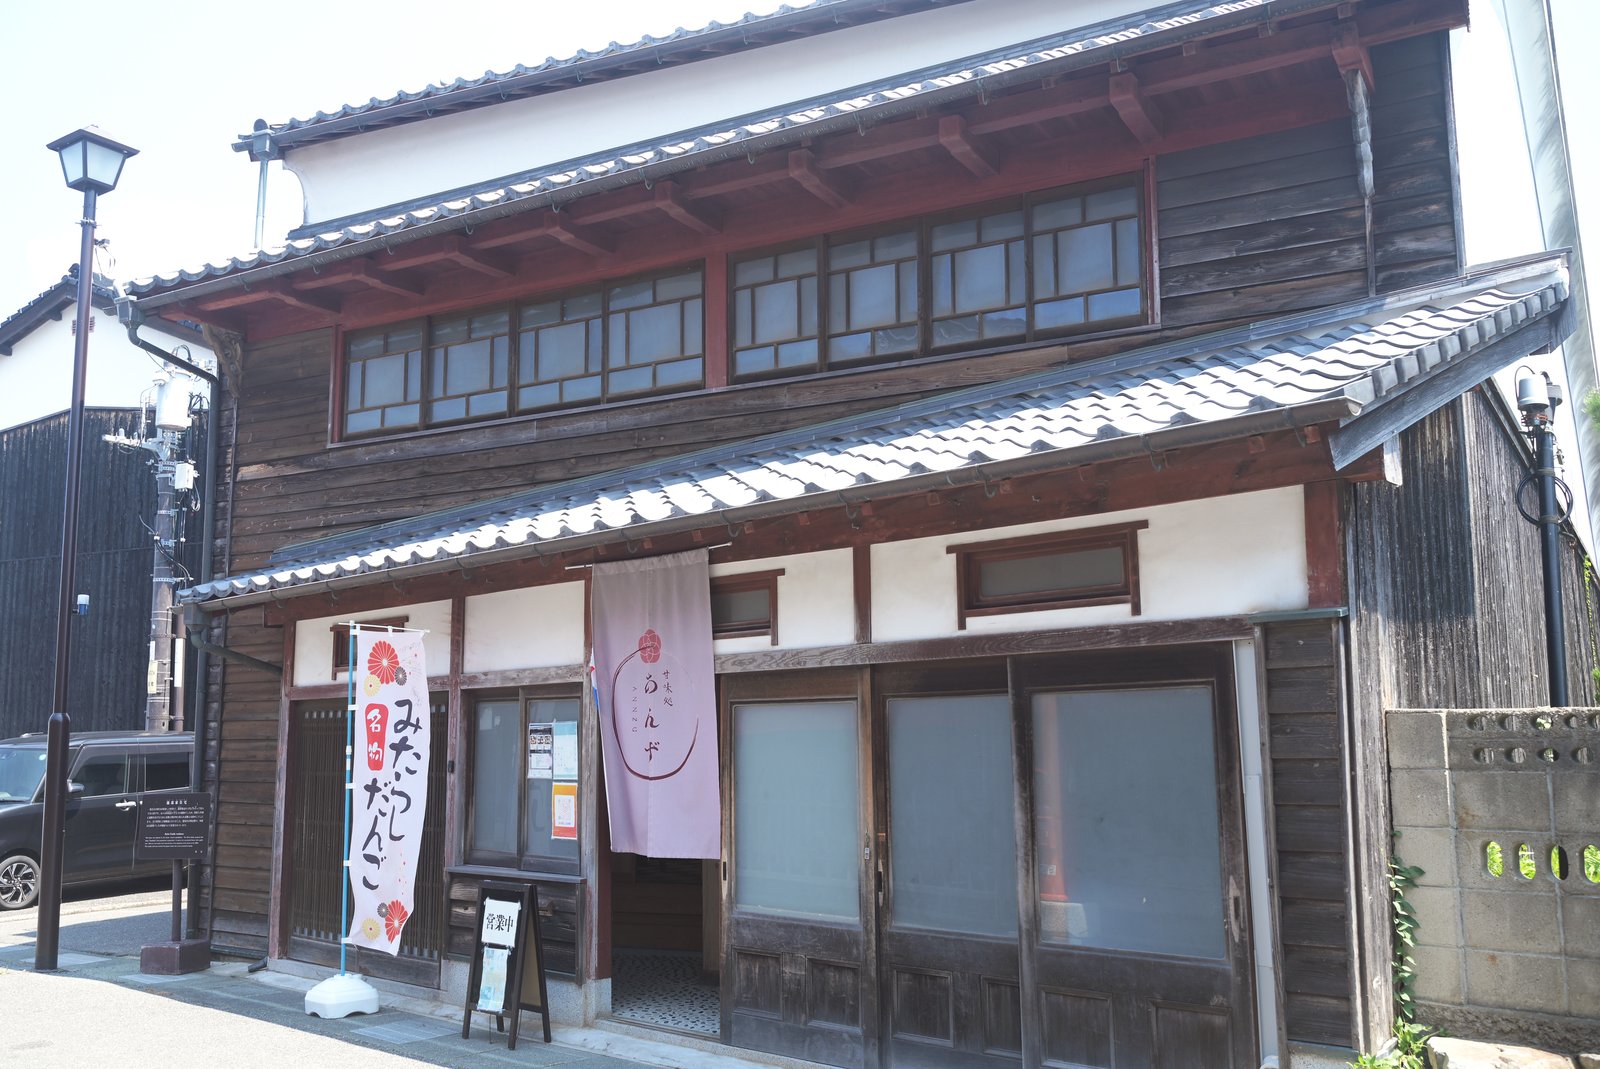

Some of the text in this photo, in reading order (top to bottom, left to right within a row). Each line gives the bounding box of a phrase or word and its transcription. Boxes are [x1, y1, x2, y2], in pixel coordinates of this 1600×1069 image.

[662, 669, 674, 707] 甘味処
[366, 708, 384, 763] 名物
[388, 698, 423, 841] みたらし
[361, 777, 392, 891] だんご
[486, 913, 514, 933] 営業中
